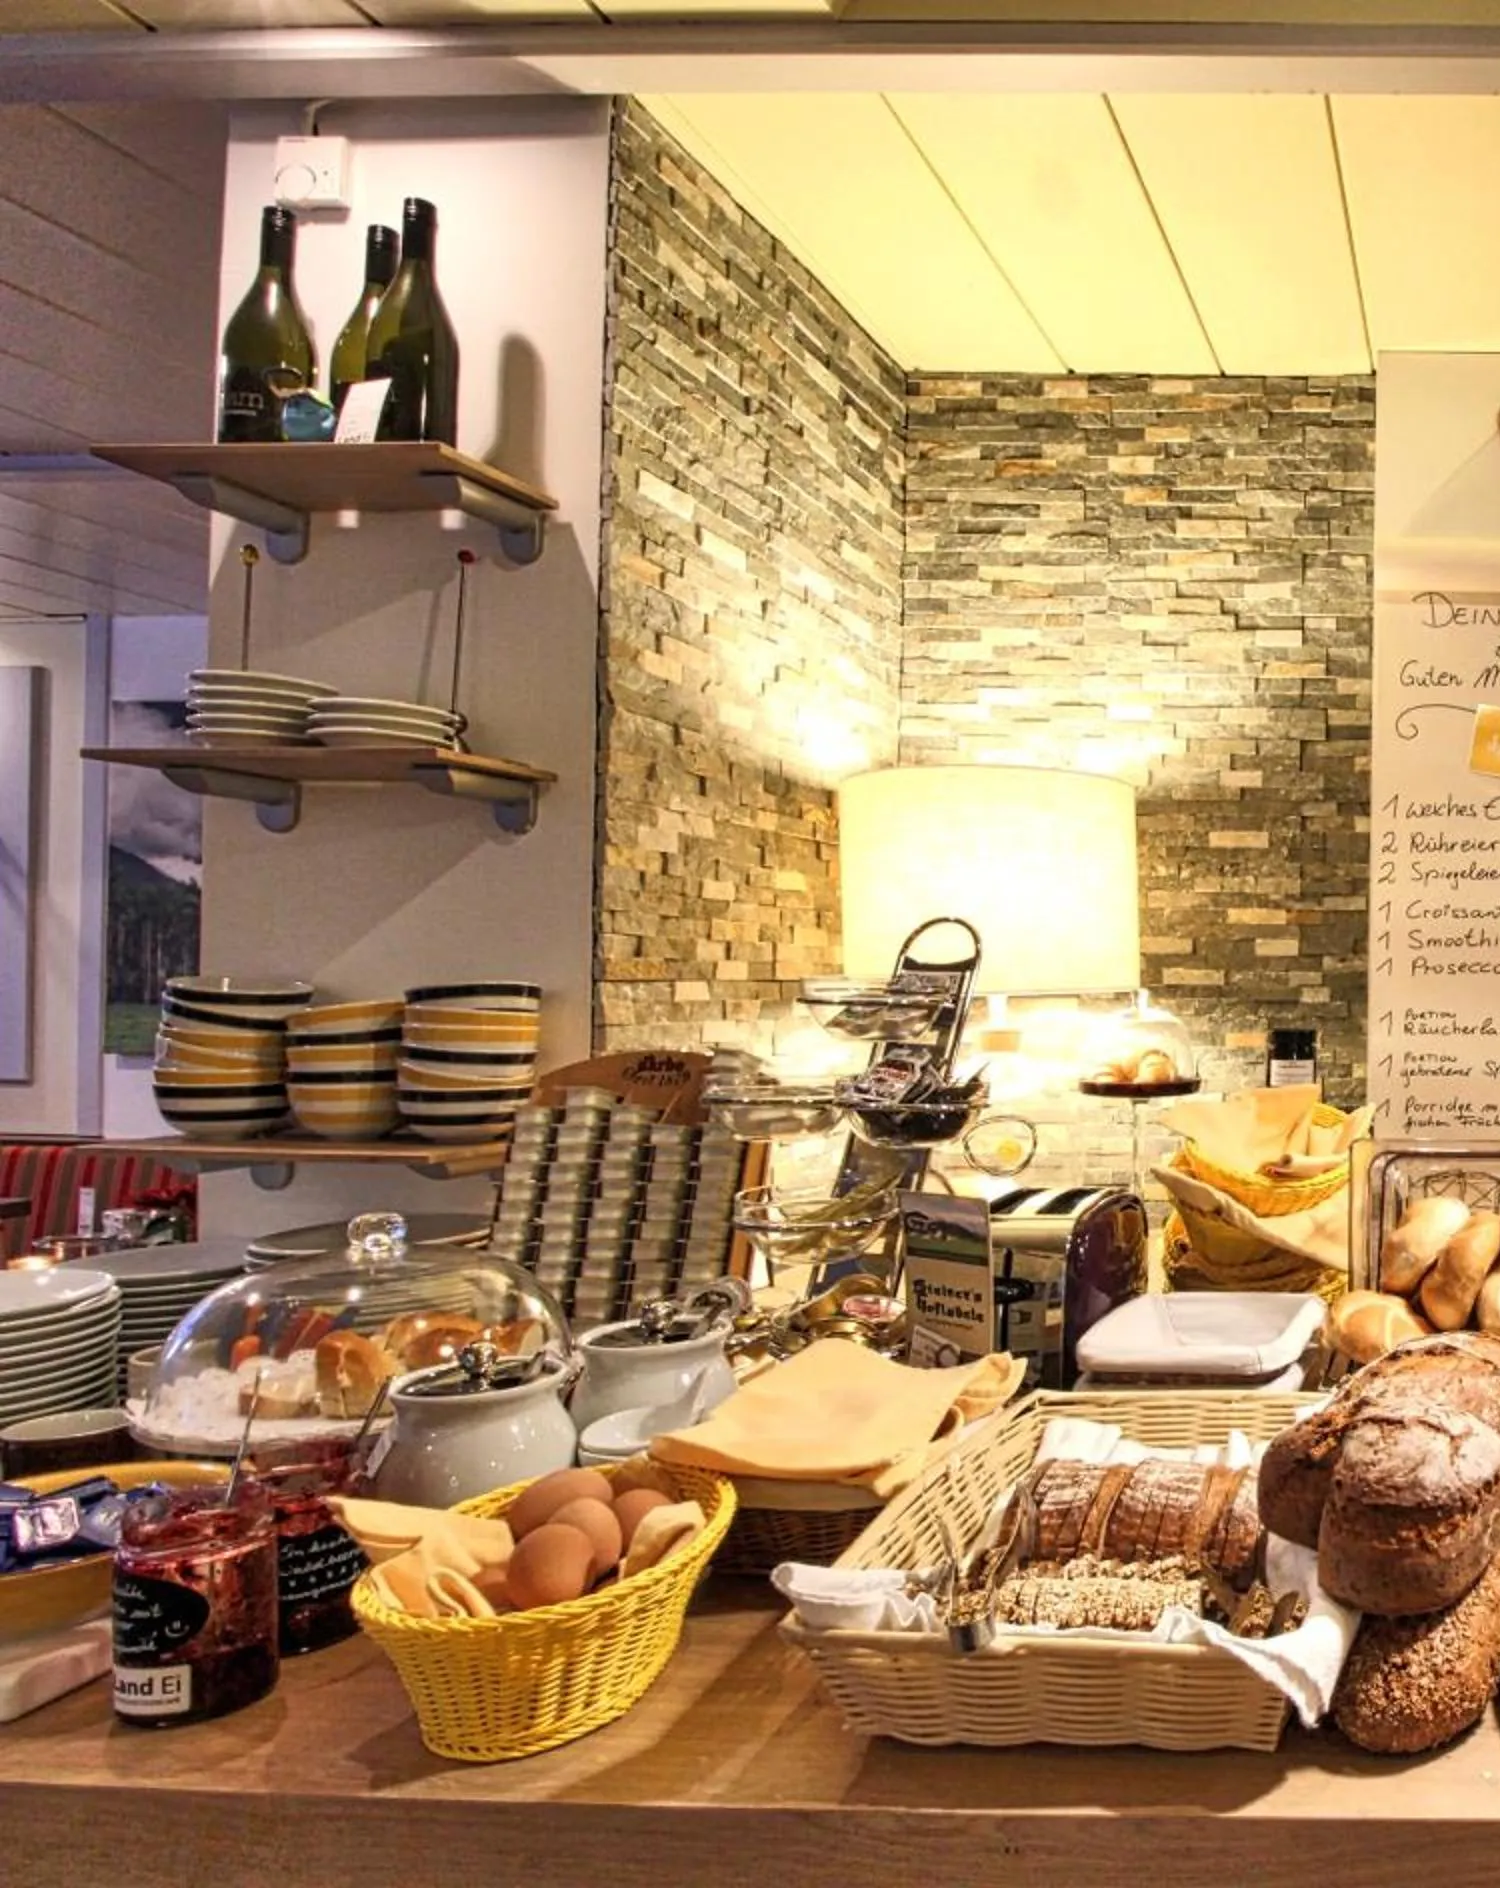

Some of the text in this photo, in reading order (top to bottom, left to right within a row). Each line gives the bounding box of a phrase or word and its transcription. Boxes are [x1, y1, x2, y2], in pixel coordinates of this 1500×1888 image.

[1400, 660, 1463, 689] Guten
[1383, 792, 1399, 819] 1
[1405, 792, 1478, 819] weiches
[1381, 831, 1398, 854] 2
[1409, 831, 1500, 854] Rühreier
[1378, 861, 1397, 885] 2
[1378, 901, 1392, 921] 1
[1377, 927, 1391, 948] 1
[1376, 957, 1393, 976] 1
[1379, 1010, 1393, 1037] 1
[1378, 1054, 1393, 1078] 1
[1376, 1098, 1391, 1118] 1
[1404, 1095, 1473, 1116] Porridge
[161, 1673, 182, 1695] Ei
